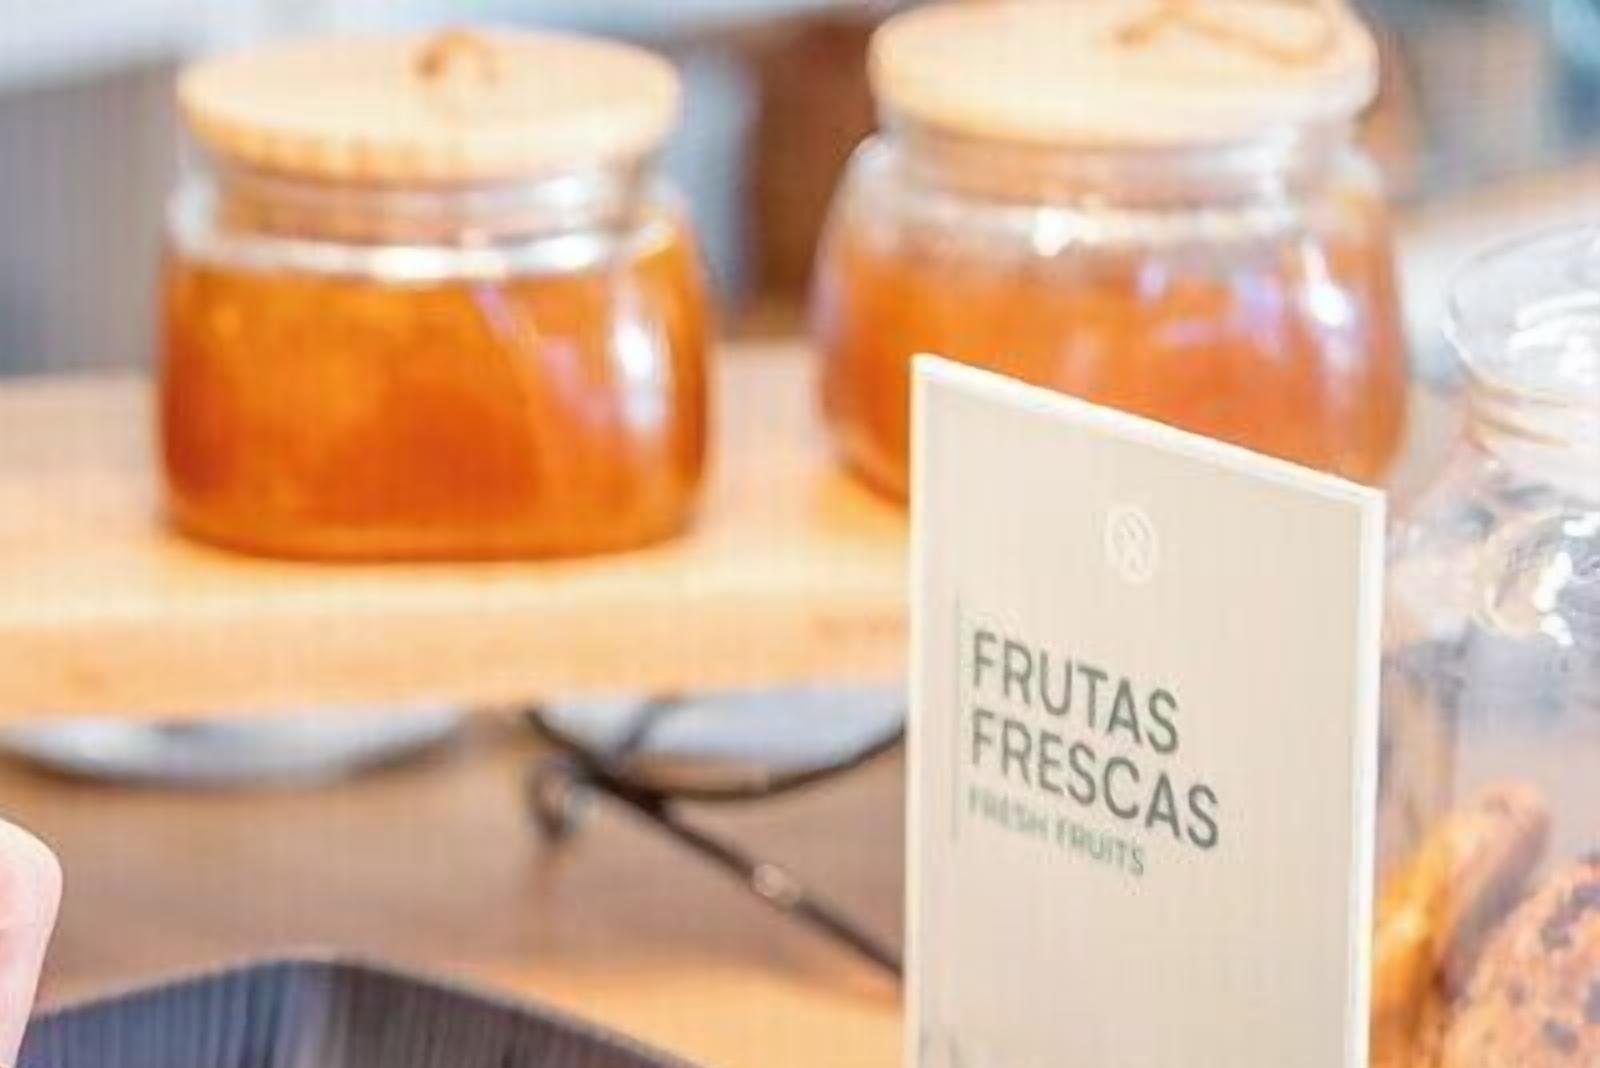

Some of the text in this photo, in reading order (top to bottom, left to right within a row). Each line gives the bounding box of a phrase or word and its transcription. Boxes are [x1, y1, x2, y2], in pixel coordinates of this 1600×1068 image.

[972, 629, 1179, 754] FRUTAS
[968, 785, 1146, 876] FRESH FRUITS
[971, 708, 1219, 850] FRESCAS
